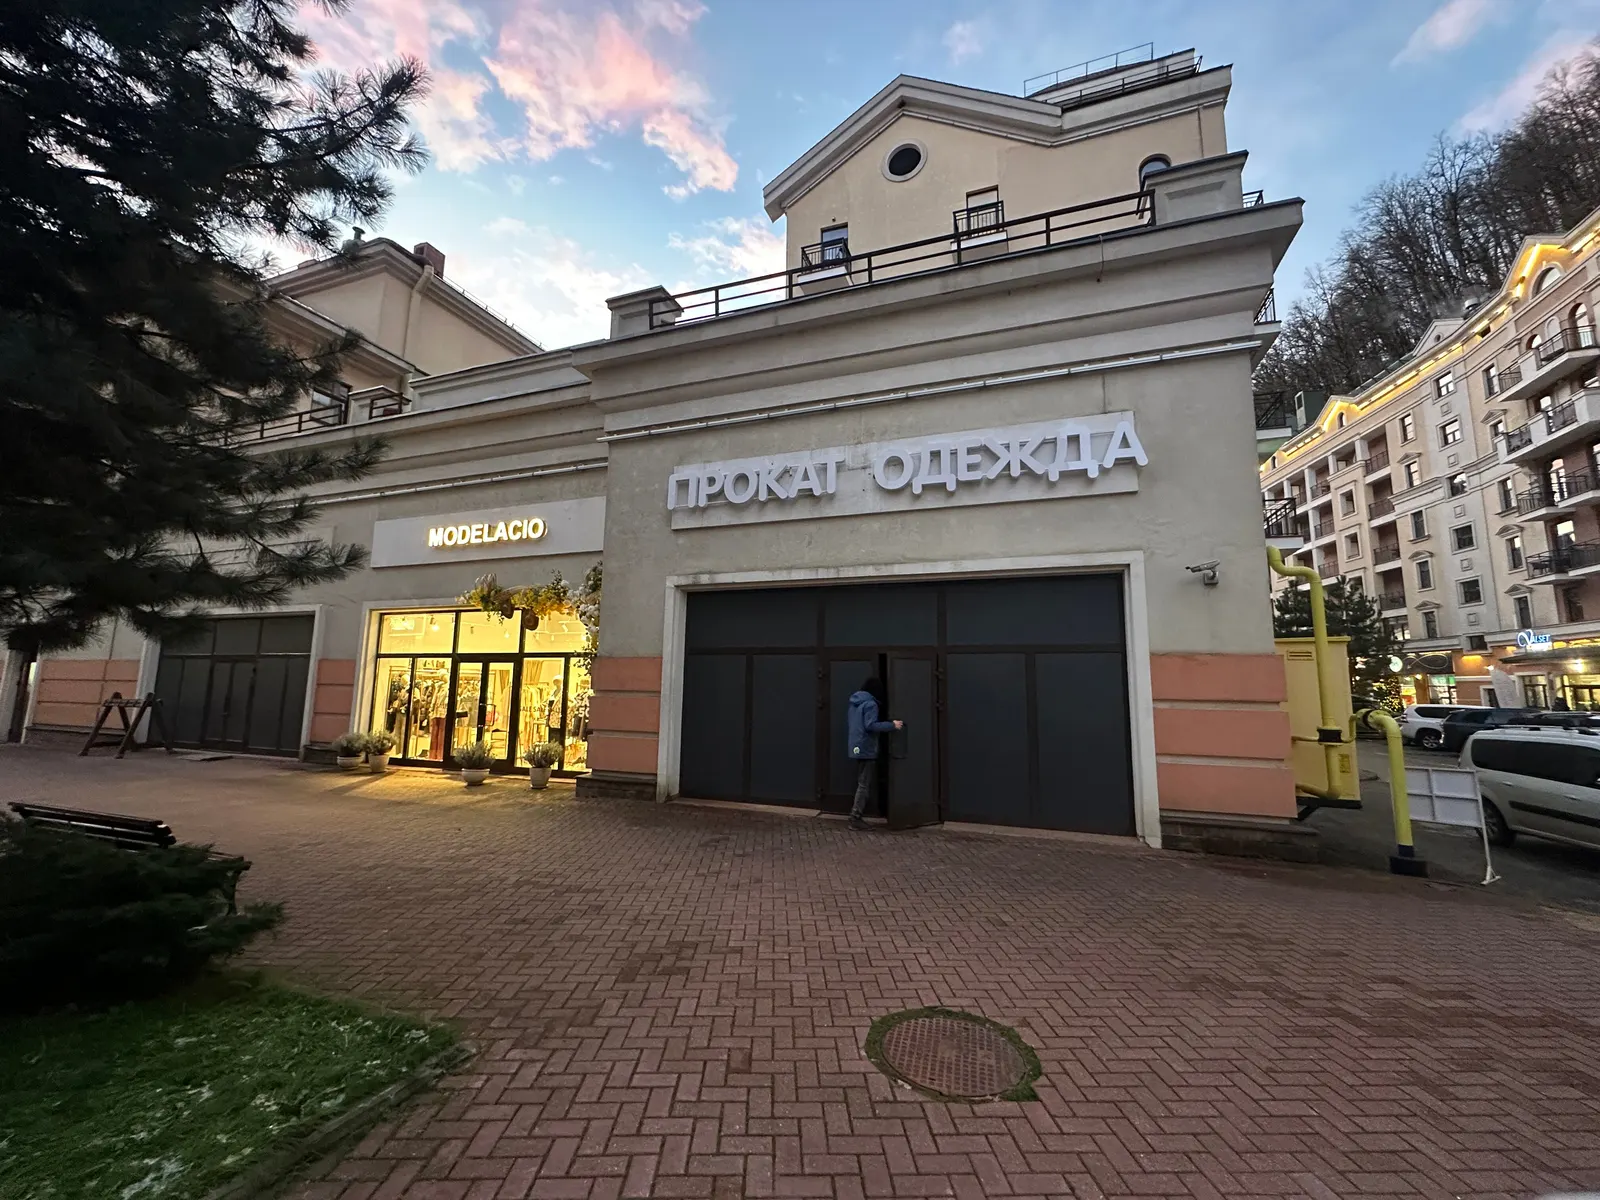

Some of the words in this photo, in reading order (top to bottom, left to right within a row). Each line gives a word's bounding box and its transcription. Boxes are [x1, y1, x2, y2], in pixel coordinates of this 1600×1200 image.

[667, 455, 845, 510] ПРОКАТ
[873, 421, 1148, 495] ОДЕЖДА
[428, 518, 548, 547] MODELACIO
